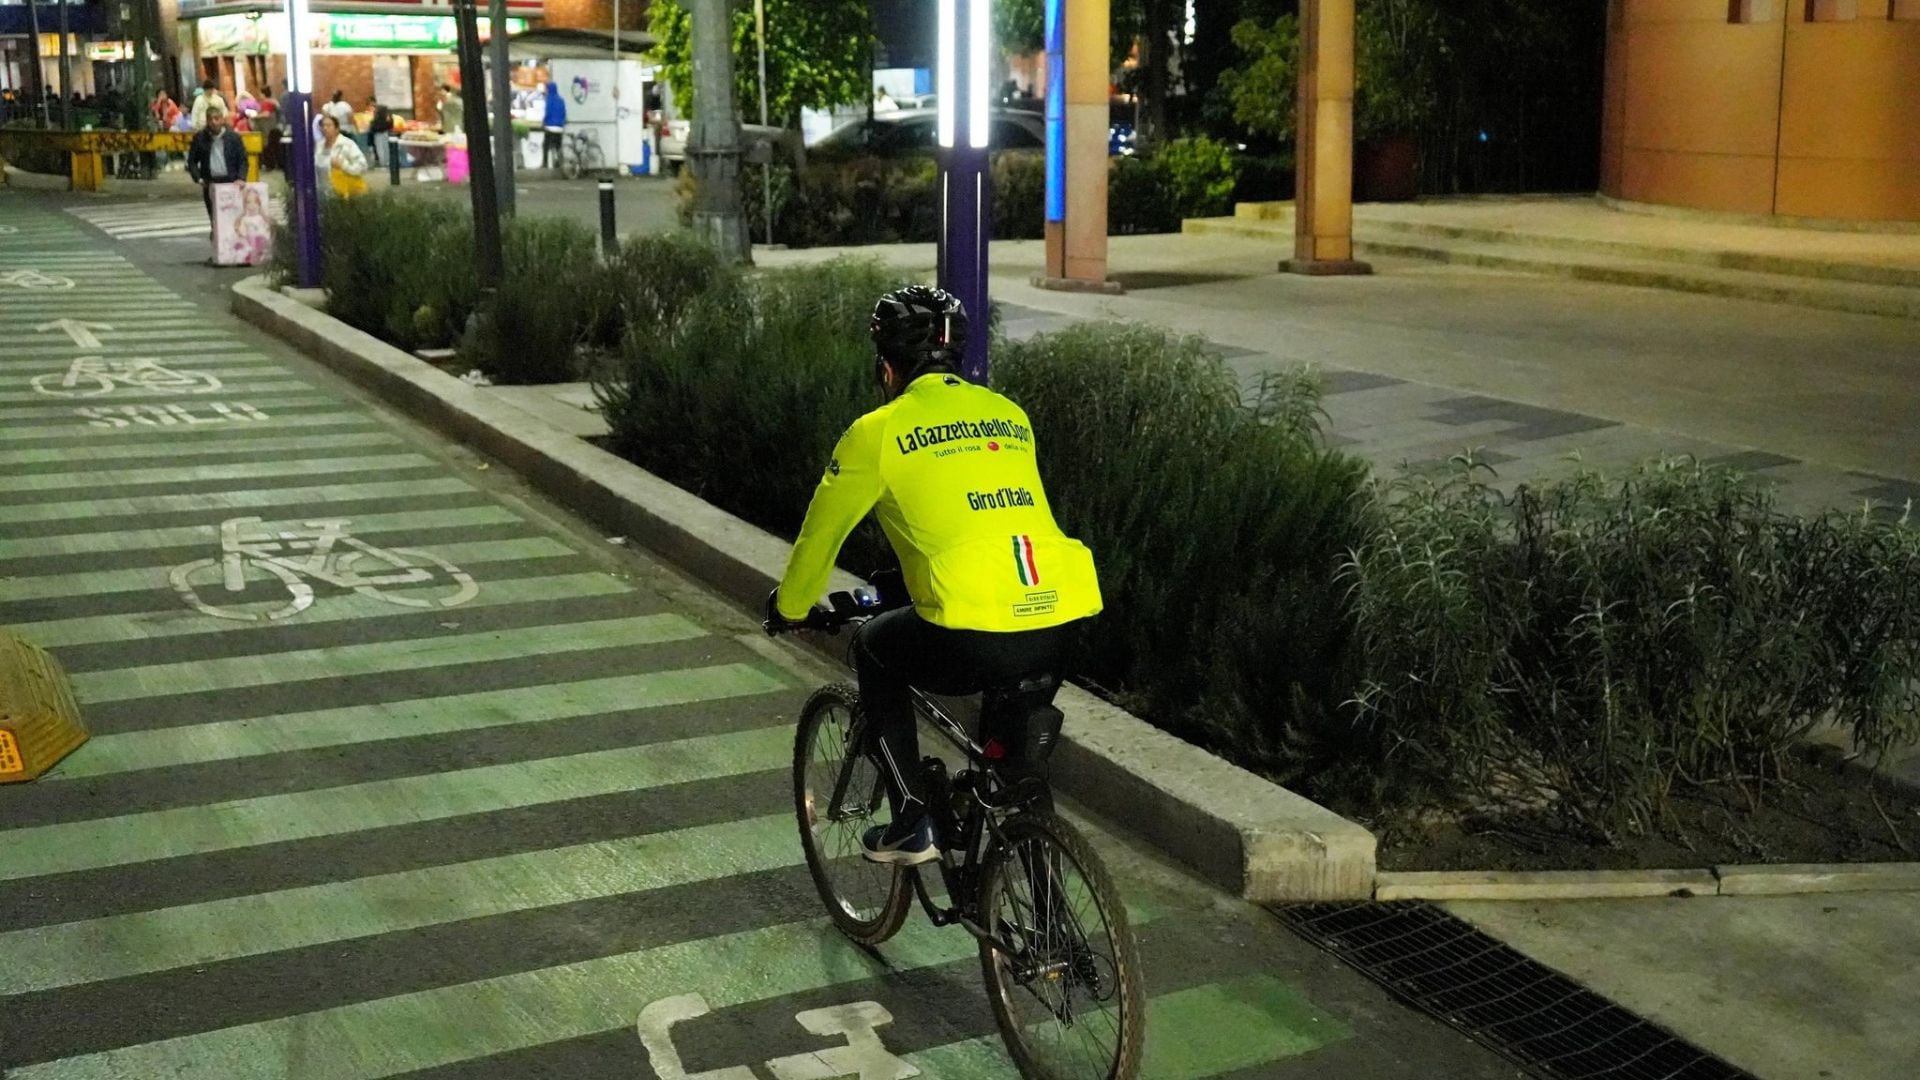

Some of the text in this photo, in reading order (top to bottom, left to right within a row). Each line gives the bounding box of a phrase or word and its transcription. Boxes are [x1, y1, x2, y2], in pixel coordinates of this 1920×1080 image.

[74, 401, 270, 428] SOLO
[896, 435, 919, 455] La
[913, 420, 981, 448] Gazzetta
[979, 418, 1011, 437] dello
[934, 449, 956, 458] Tutto
[967, 487, 1035, 511] Giro d'Italia
